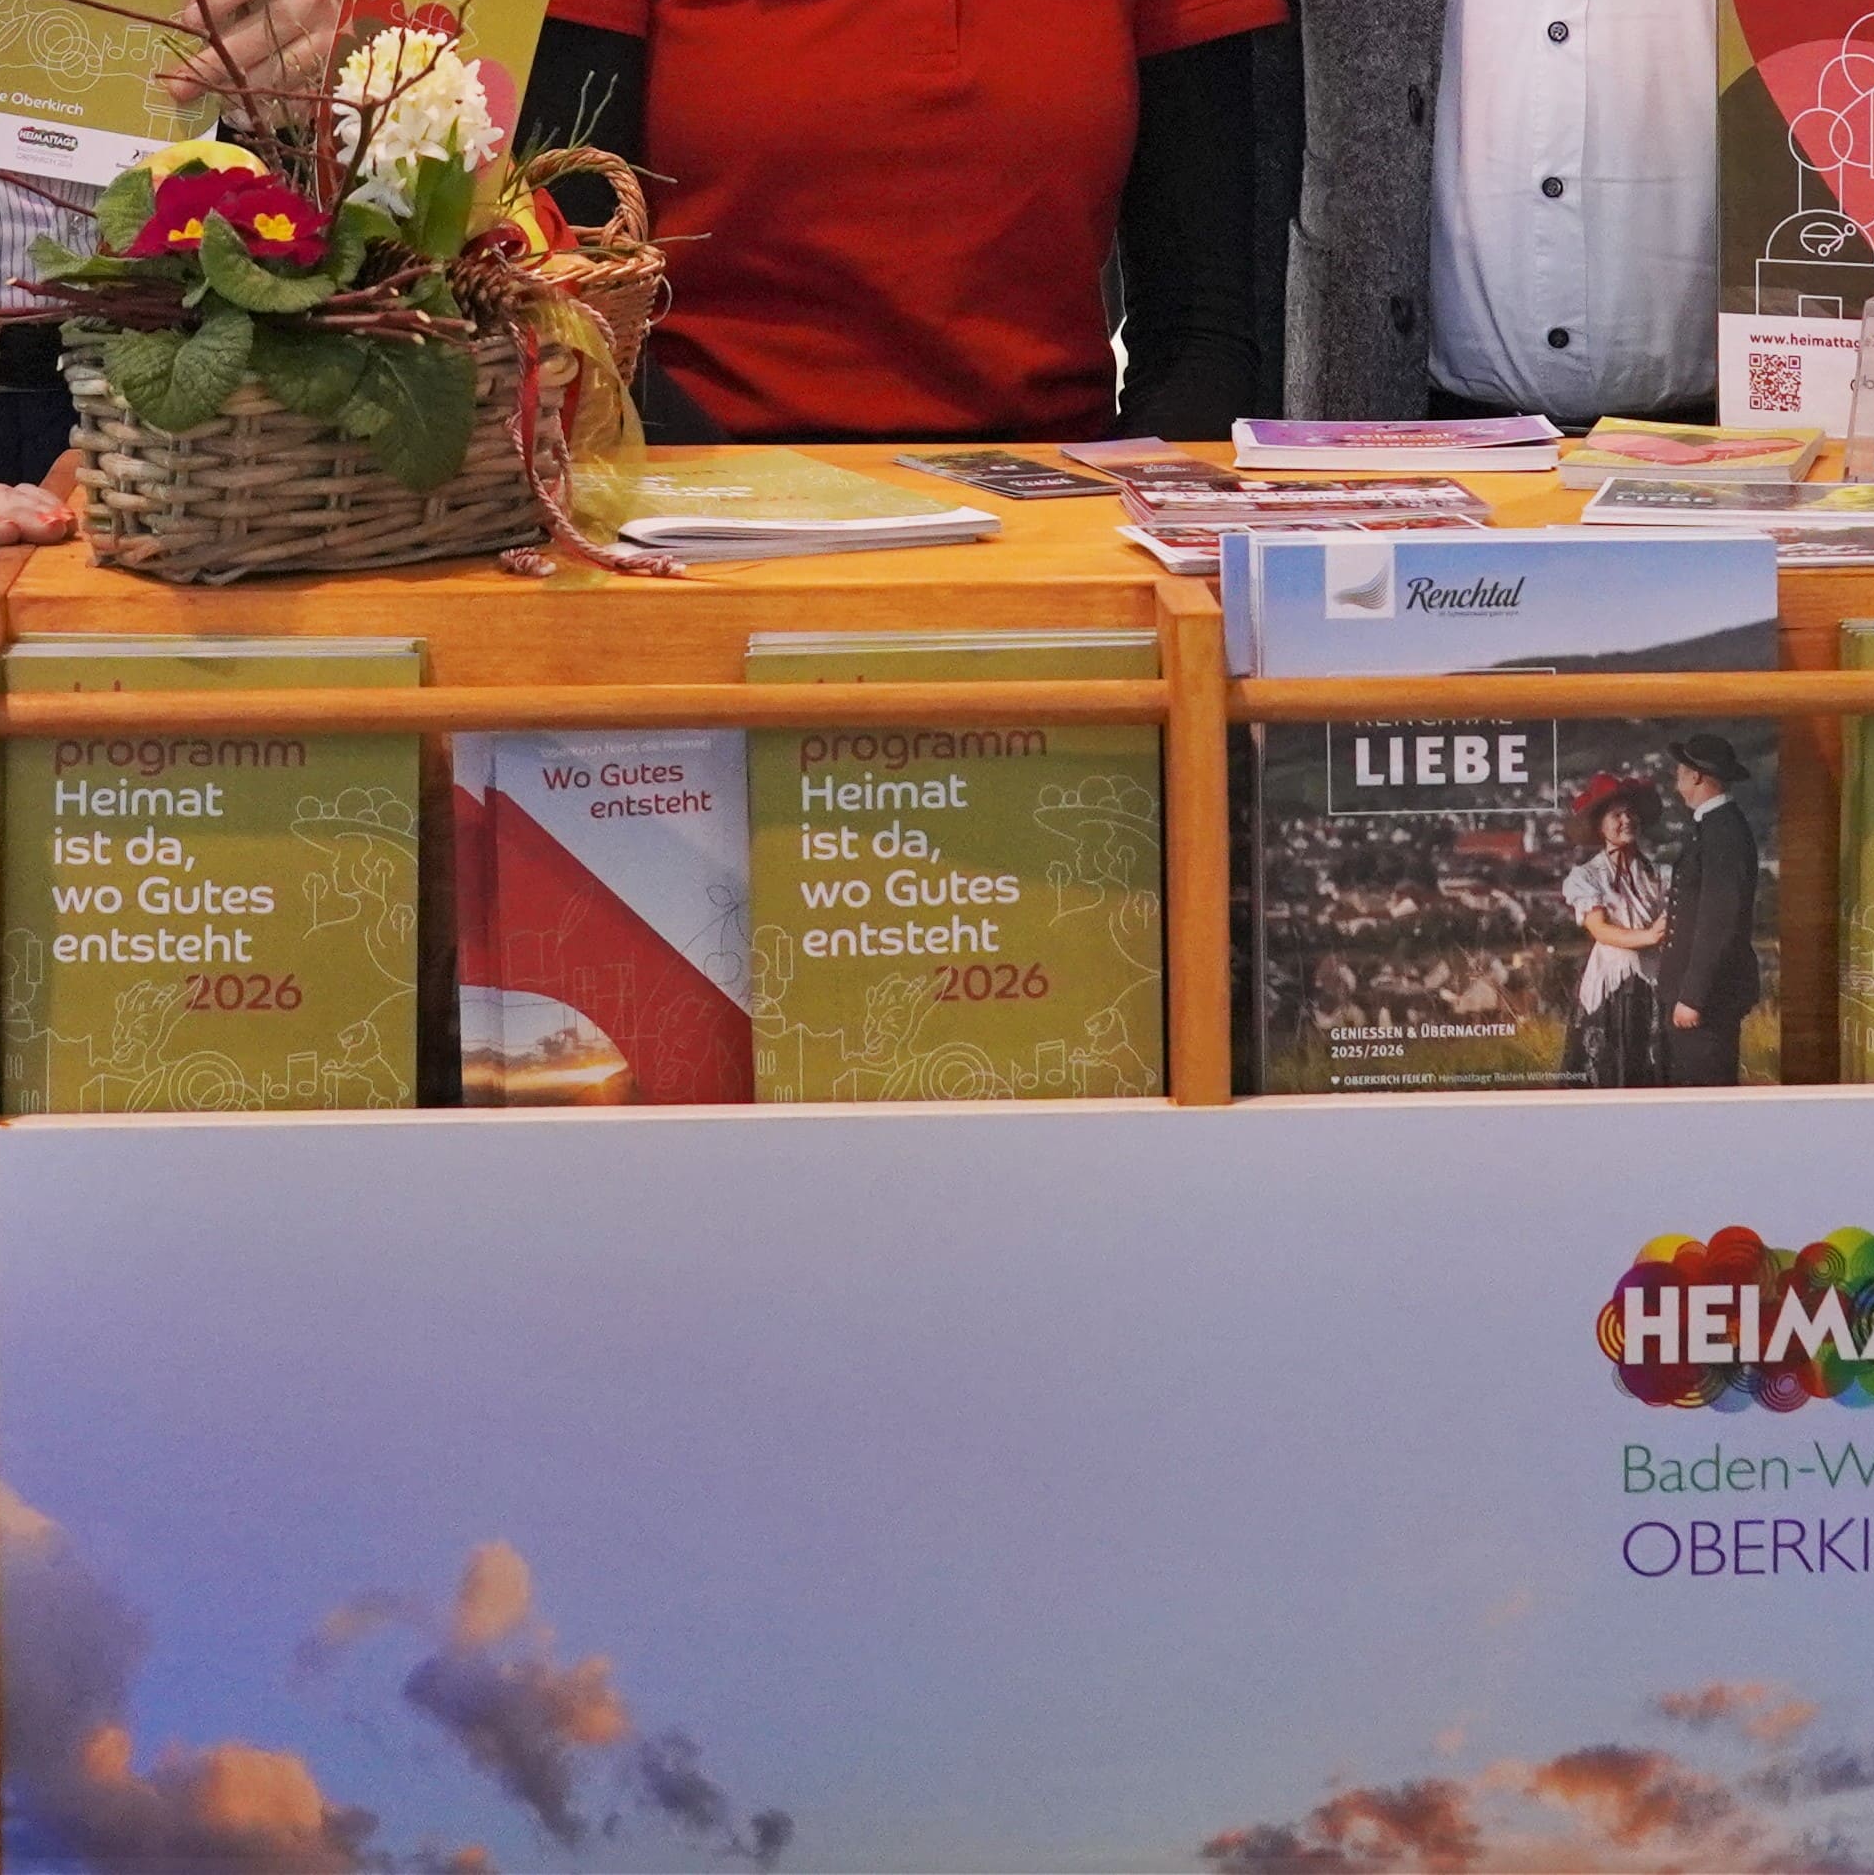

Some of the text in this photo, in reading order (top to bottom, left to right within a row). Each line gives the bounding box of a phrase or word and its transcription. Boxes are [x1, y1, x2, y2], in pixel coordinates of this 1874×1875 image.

[11, 92, 85, 117] Oberkirch
[18, 128, 78, 150] HEIMATTAGE
[1406, 575, 1526, 614] Renchtal
[53, 737, 307, 777] programm
[799, 729, 1049, 772] programm
[1355, 734, 1529, 787] LIEBE
[542, 762, 685, 790] Wo Gutes
[800, 773, 969, 812] Heimat
[54, 778, 224, 818] Heimat
[590, 789, 713, 819] entsteht
[53, 825, 196, 873] ist da,
[800, 820, 942, 866] ist da,
[52, 876, 276, 916] wo Gutes
[800, 869, 1022, 910] wo Gutes
[53, 924, 253, 964] entsteht
[801, 915, 1000, 959] entsteht
[184, 972, 304, 1012] 2026
[932, 964, 1050, 1003] 2026
[1330, 1023, 1516, 1041] GENIESSEN & ÜBERNACHTEN
[1330, 1044, 1405, 1058] 2025/2026
